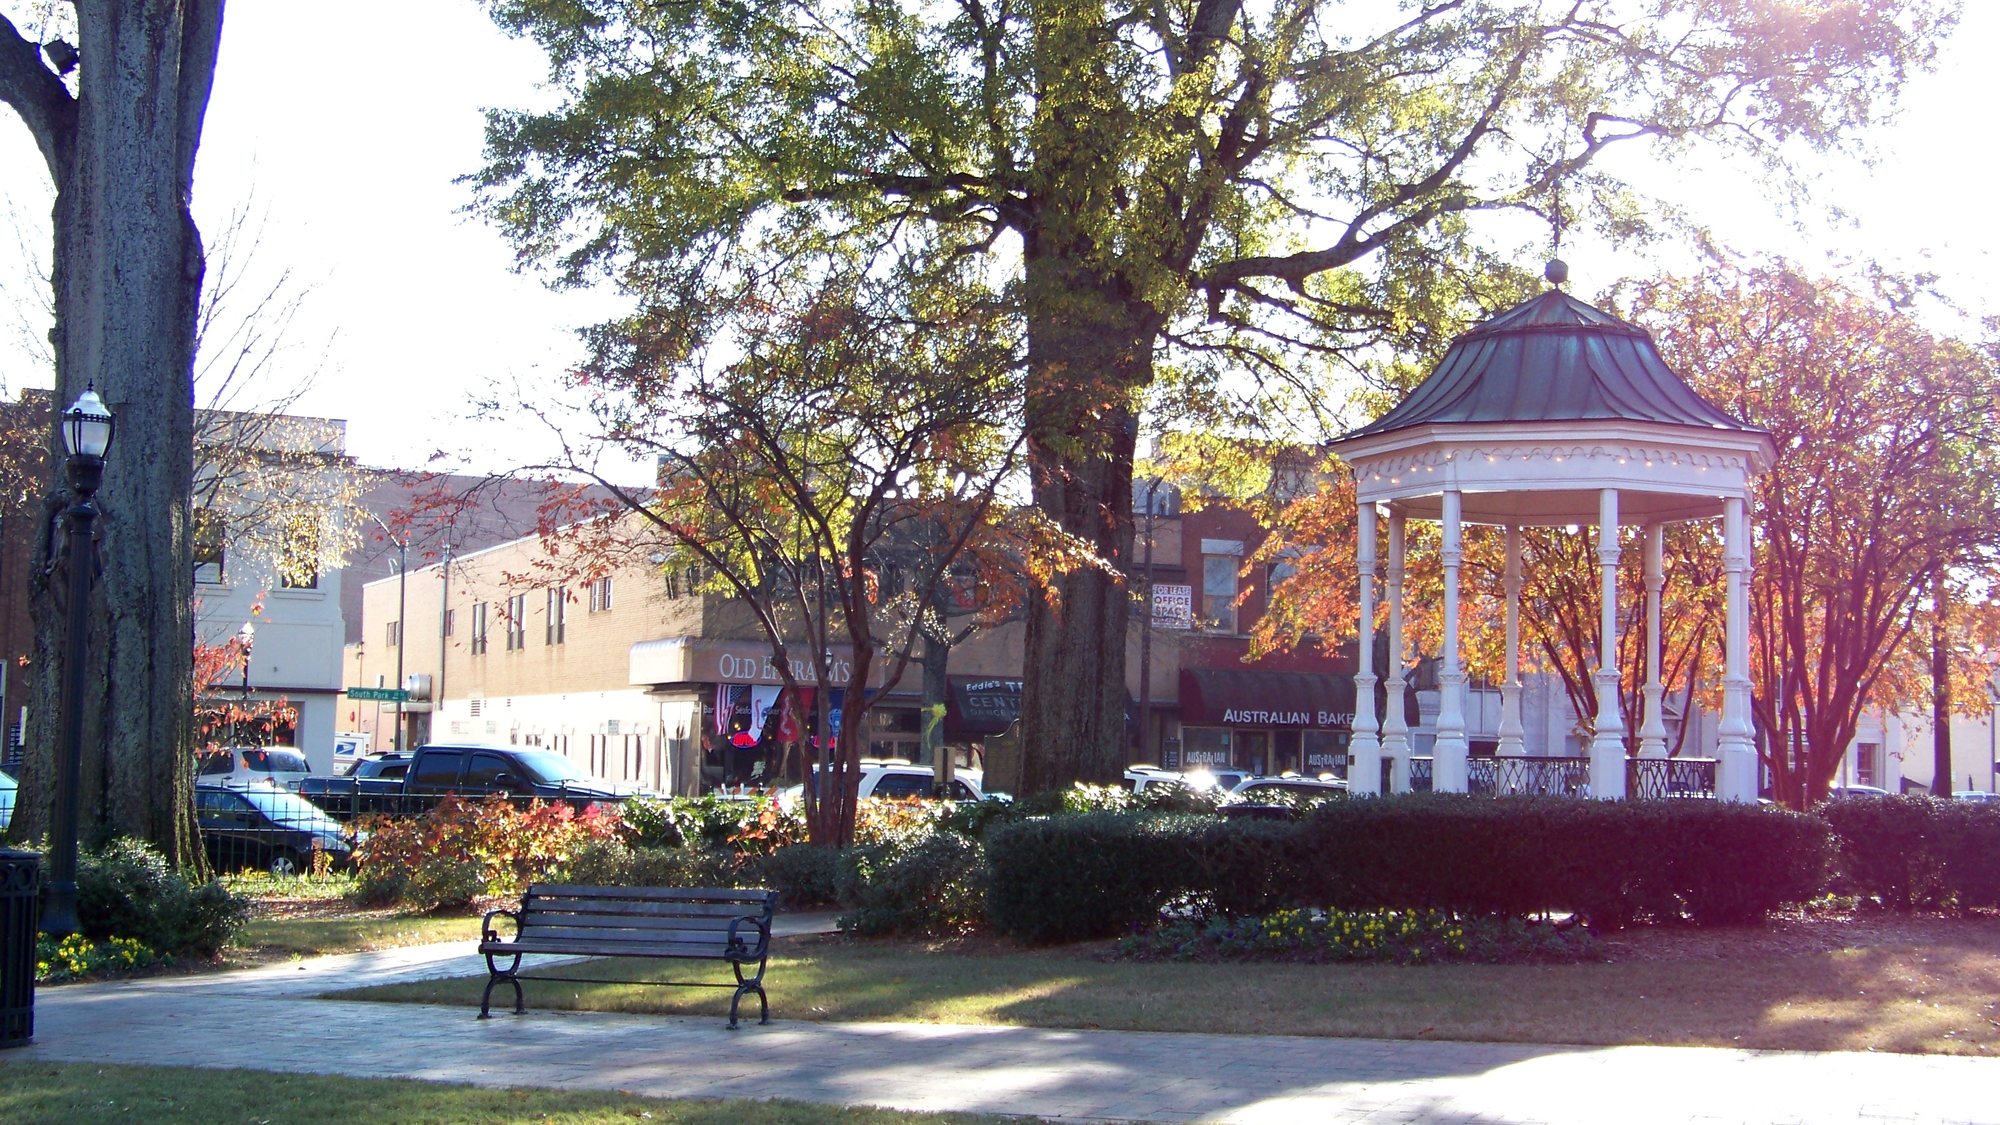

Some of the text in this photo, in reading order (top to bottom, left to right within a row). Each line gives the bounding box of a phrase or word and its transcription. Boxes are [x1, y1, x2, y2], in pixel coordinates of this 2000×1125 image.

[1154, 596, 1190, 606] OFFICE
[1155, 607, 1188, 616] SPACE
[720, 654, 756, 678] OLD
[966, 681, 1000, 691] Eddie's
[350, 690, 371, 698] South
[373, 691, 389, 699] Park
[1223, 708, 1310, 724] AUSTRALIAN
[1308, 754, 1346, 768] AUSTRALIAN
